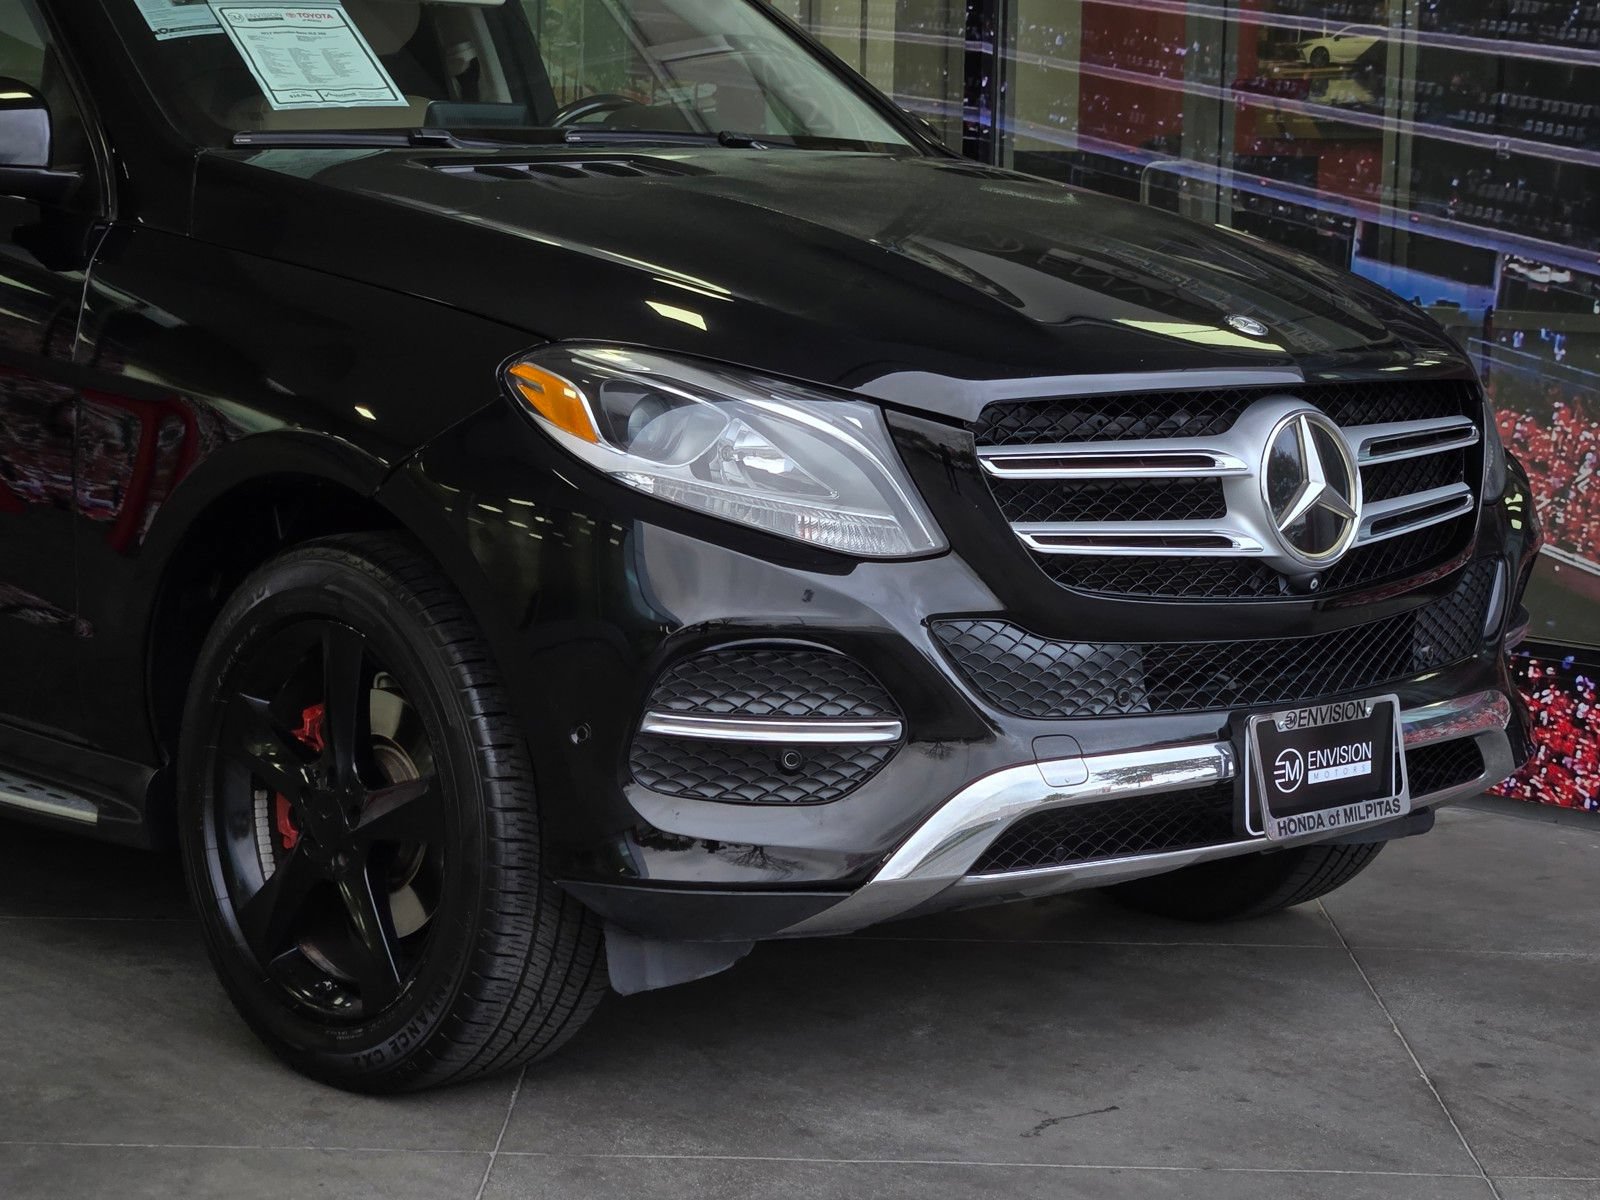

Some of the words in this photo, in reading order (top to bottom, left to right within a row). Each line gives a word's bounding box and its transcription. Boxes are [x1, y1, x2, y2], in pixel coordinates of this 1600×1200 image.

[1298, 700, 1367, 728] ENVISION
[1308, 741, 1372, 769] ENVISION
[1314, 766, 1367, 781] MOTORS
[1277, 814, 1325, 836] HONDA
[1328, 811, 1340, 826] of
[1344, 798, 1401, 823] MILPITAS
